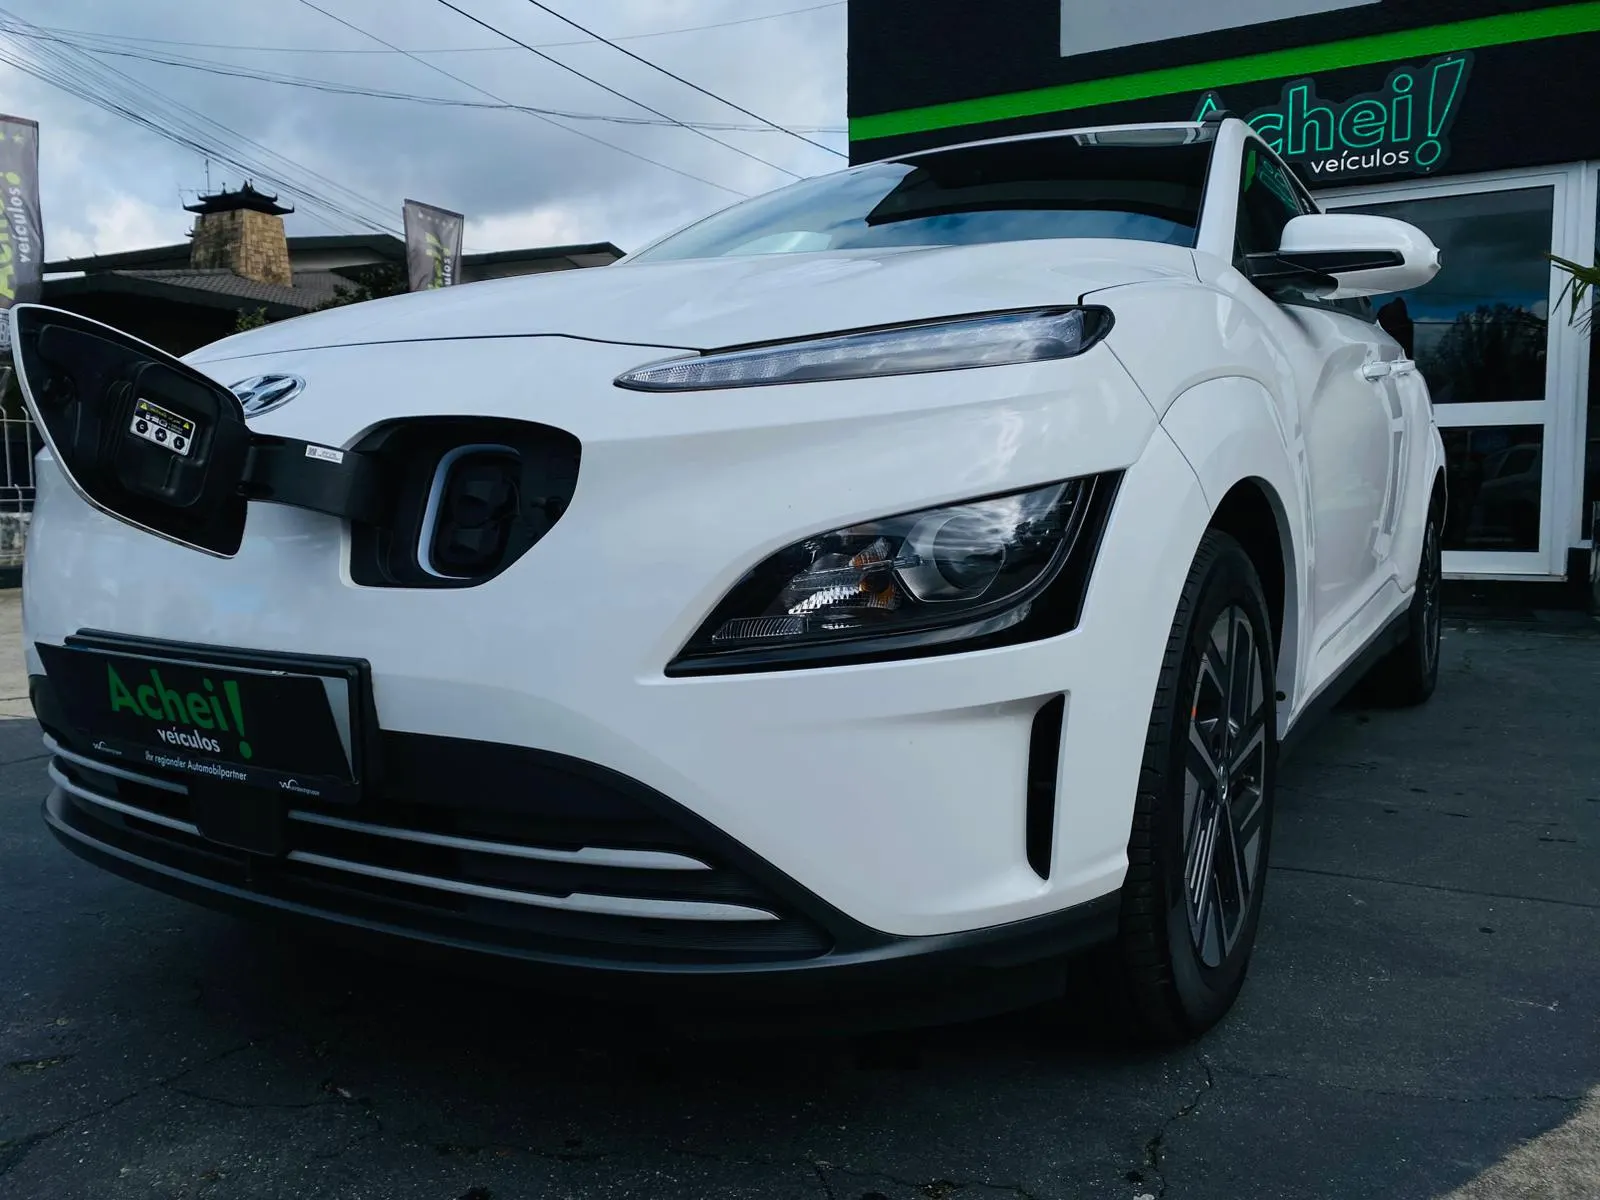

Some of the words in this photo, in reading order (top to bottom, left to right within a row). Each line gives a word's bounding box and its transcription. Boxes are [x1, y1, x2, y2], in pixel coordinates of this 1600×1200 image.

[1310, 149, 1410, 174] veículos
[7, 186, 31, 263] veículos
[107, 661, 252, 759] Achei!
[157, 726, 221, 753] veículos
[154, 755, 186, 767] regionaler
[187, 760, 247, 780] Automobilpartner
